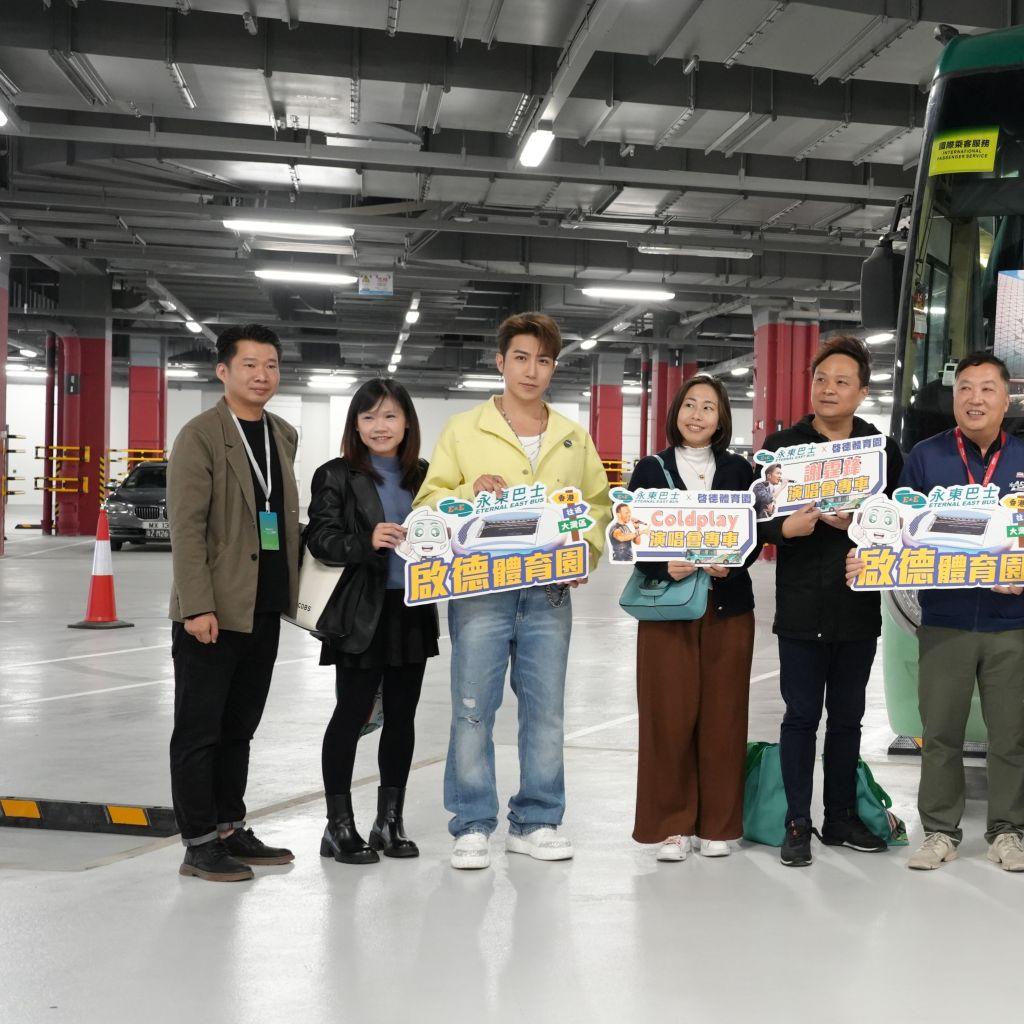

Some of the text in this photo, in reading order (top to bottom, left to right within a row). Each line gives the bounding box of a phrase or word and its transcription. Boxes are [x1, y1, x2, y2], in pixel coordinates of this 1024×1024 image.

[776, 446, 816, 458] 永東巴士
[476, 485, 544, 508] 永東巴士
[635, 491, 680, 500] 永東巴士
[787, 476, 869, 502] 演唱會專車
[931, 486, 997, 501] 永東巴士
[476, 503, 509, 514] ETERNAL
[651, 510, 739, 530] Coldplay
[649, 530, 739, 548] 演唱會專車
[410, 546, 584, 600] 啟德體育園
